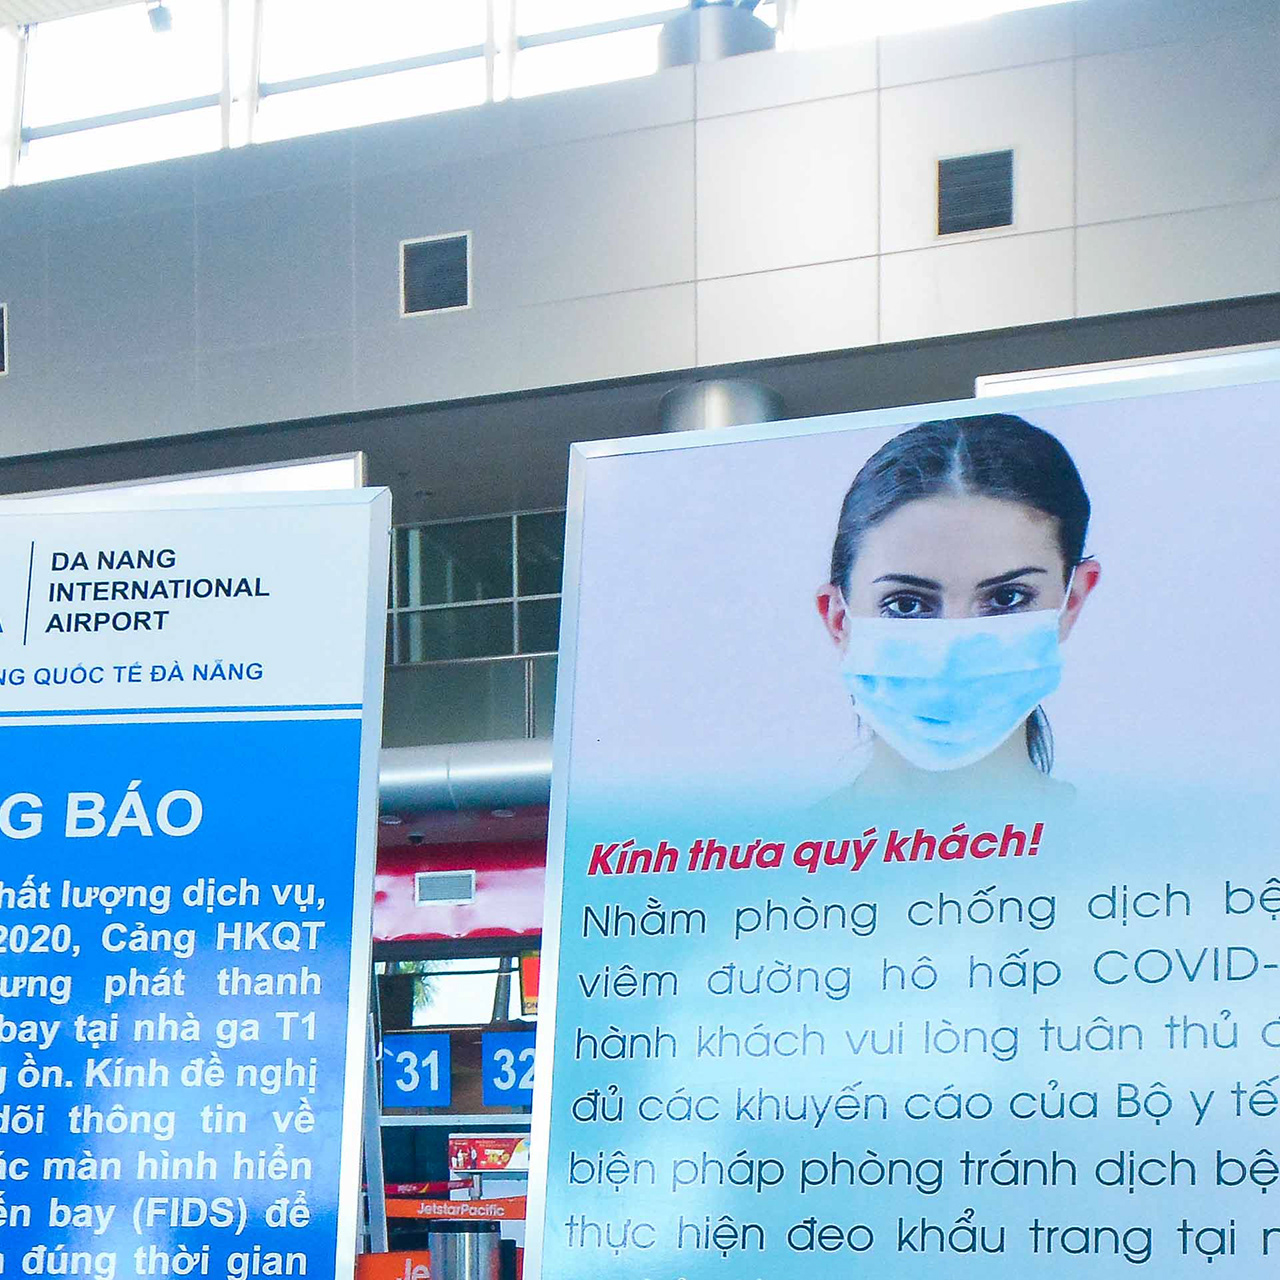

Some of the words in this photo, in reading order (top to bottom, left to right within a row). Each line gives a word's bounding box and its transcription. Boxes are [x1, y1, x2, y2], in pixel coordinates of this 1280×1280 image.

[52, 552, 89, 571] DA
[98, 549, 175, 570] NANG
[49, 578, 269, 602] INTERNATIONAL
[45, 611, 169, 633] AIRPORT
[34, 664, 104, 685] QUỐC
[113, 662, 142, 683] TẾ
[150, 664, 184, 682] ĐÀ
[193, 663, 262, 681] NẴNG
[65, 780, 202, 837] BÁO
[588, 839, 678, 875] Kính
[688, 839, 785, 871] thưa
[793, 827, 878, 873] quý
[884, 823, 1044, 862] khách!
[62, 880, 171, 914] lượng
[183, 878, 259, 913] dịch
[272, 884, 324, 912] vụ,
[584, 897, 705, 937] Nhằm
[736, 897, 876, 939] phòng
[908, 885, 1055, 930] chống
[1088, 884, 1190, 926] dịch
[102, 922, 195, 958] Cảng
[217, 921, 325, 952] HKQT
[579, 965, 677, 997] viêm
[708, 960, 850, 1000] đường
[883, 956, 937, 990] hô
[970, 948, 1061, 994] hấp
[395, 1049, 439, 1092] 31
[492, 1047, 536, 1091] 32
[417, 1201, 505, 1218] JetstarPacific
[134, 1245, 209, 1274] thời
